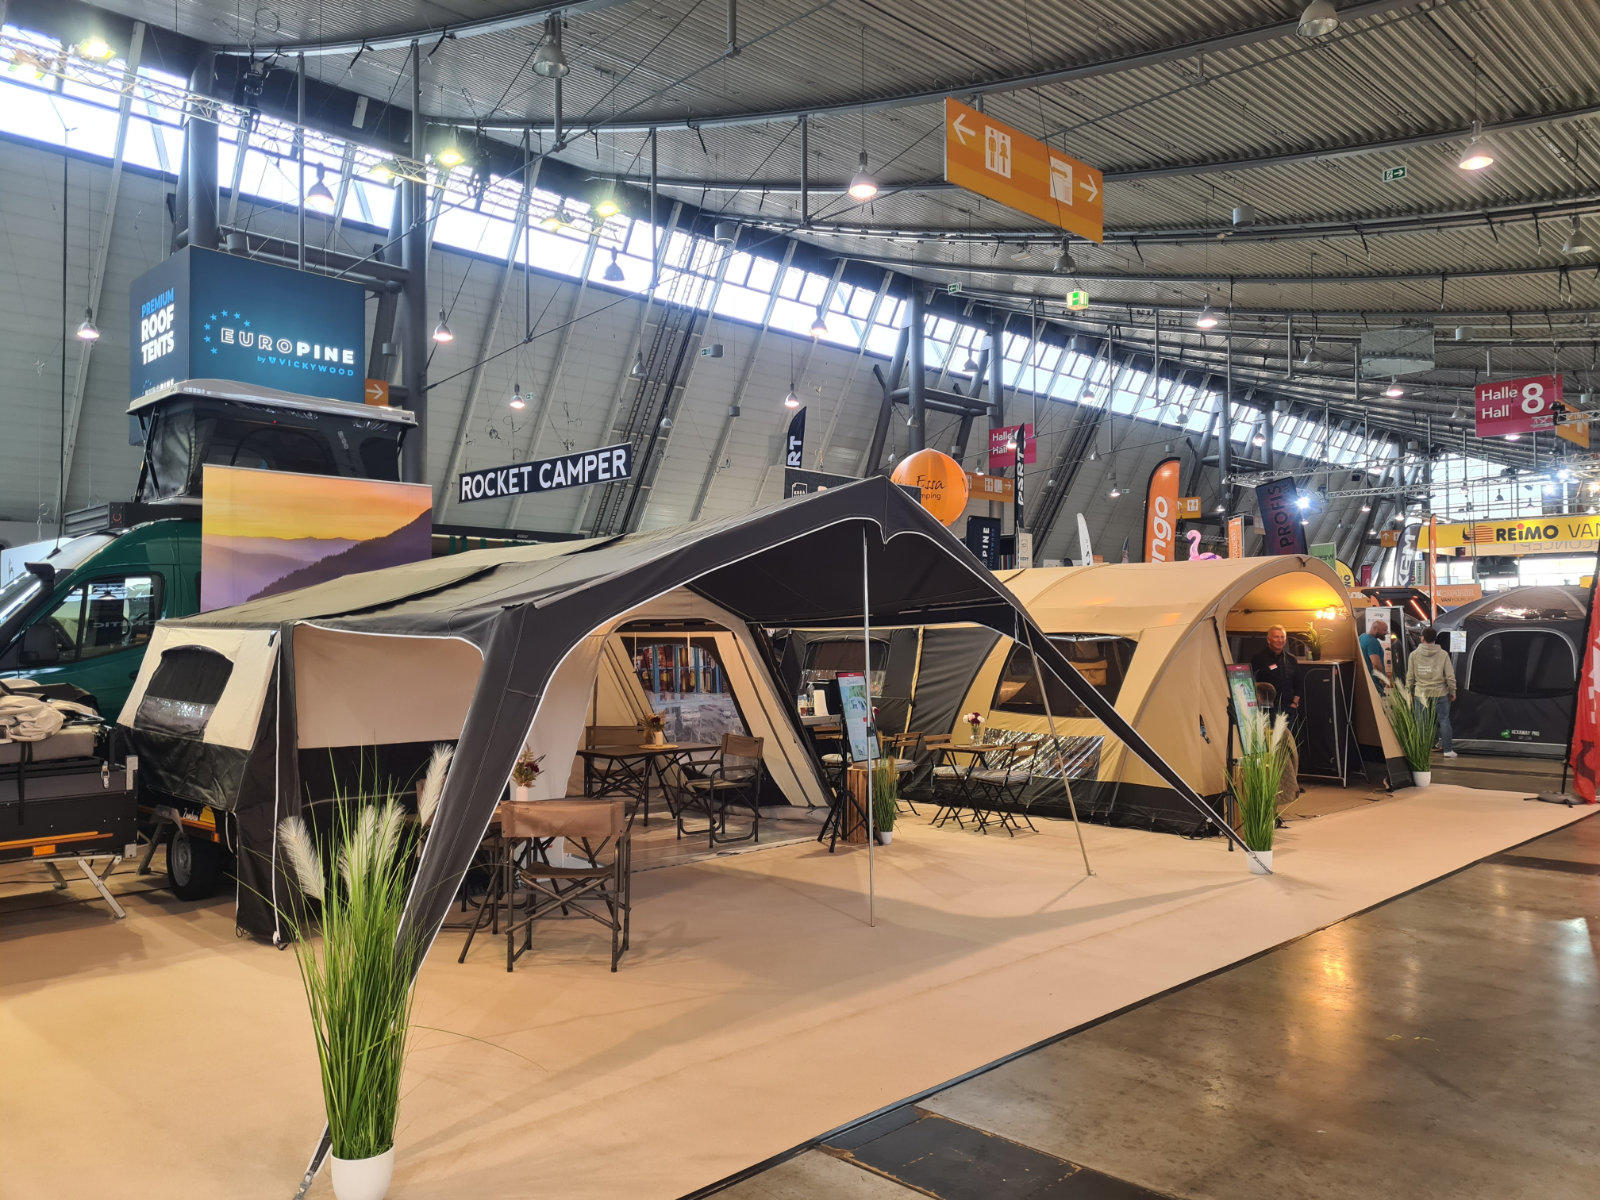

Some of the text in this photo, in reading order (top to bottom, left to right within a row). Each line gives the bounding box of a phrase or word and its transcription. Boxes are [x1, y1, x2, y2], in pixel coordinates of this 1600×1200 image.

[142, 287, 174, 318] PREMIUM
[141, 303, 174, 342] ROOF
[142, 330, 174, 365] TENTS
[221, 327, 354, 365] EUROPINE
[257, 355, 354, 377] by VICKYWOOD
[1481, 382, 1545, 414] Halle 8
[1481, 404, 1509, 419] Hall
[461, 448, 627, 501] ROCKET CAMPER
[1268, 485, 1294, 548] PROFIS
